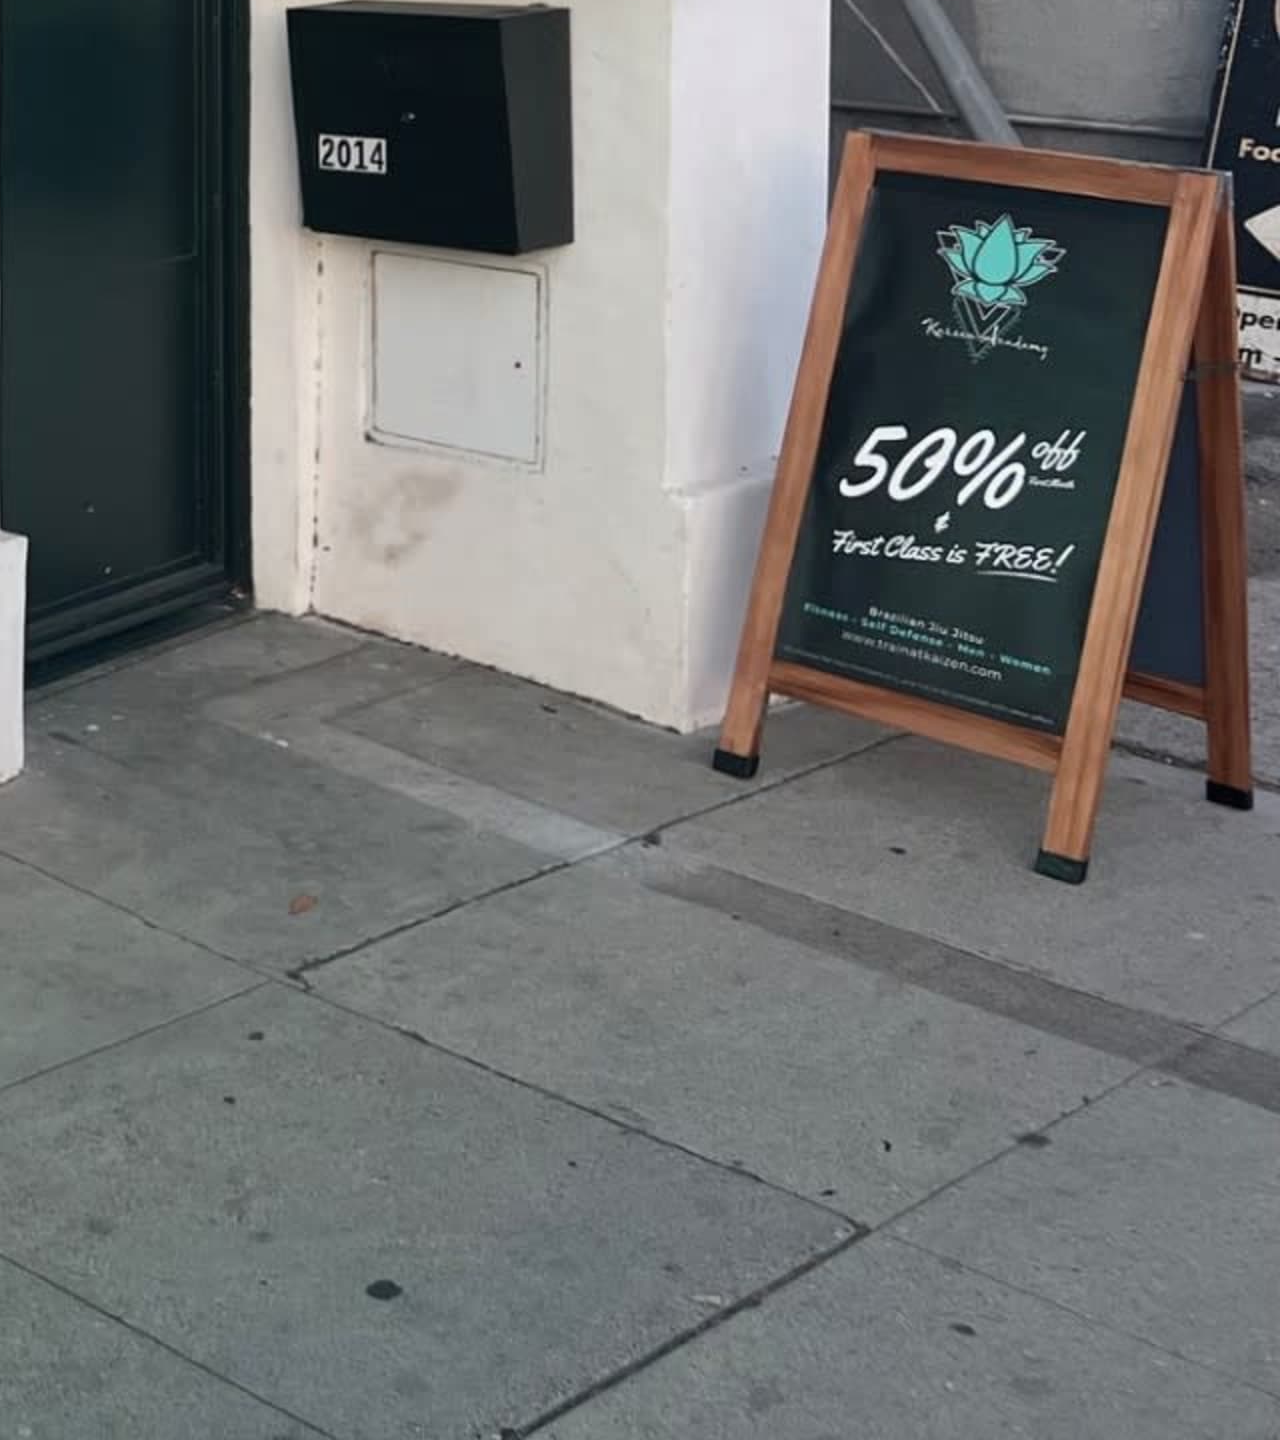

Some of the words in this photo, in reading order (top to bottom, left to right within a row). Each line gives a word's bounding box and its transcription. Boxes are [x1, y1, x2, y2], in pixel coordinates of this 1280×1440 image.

[321, 138, 384, 171] 2014
[839, 425, 1026, 509] 50%
[1031, 429, 1087, 472] off
[832, 530, 884, 557] First
[884, 535, 942, 564] Class
[945, 544, 968, 564] is
[975, 544, 1076, 574] FREE!
